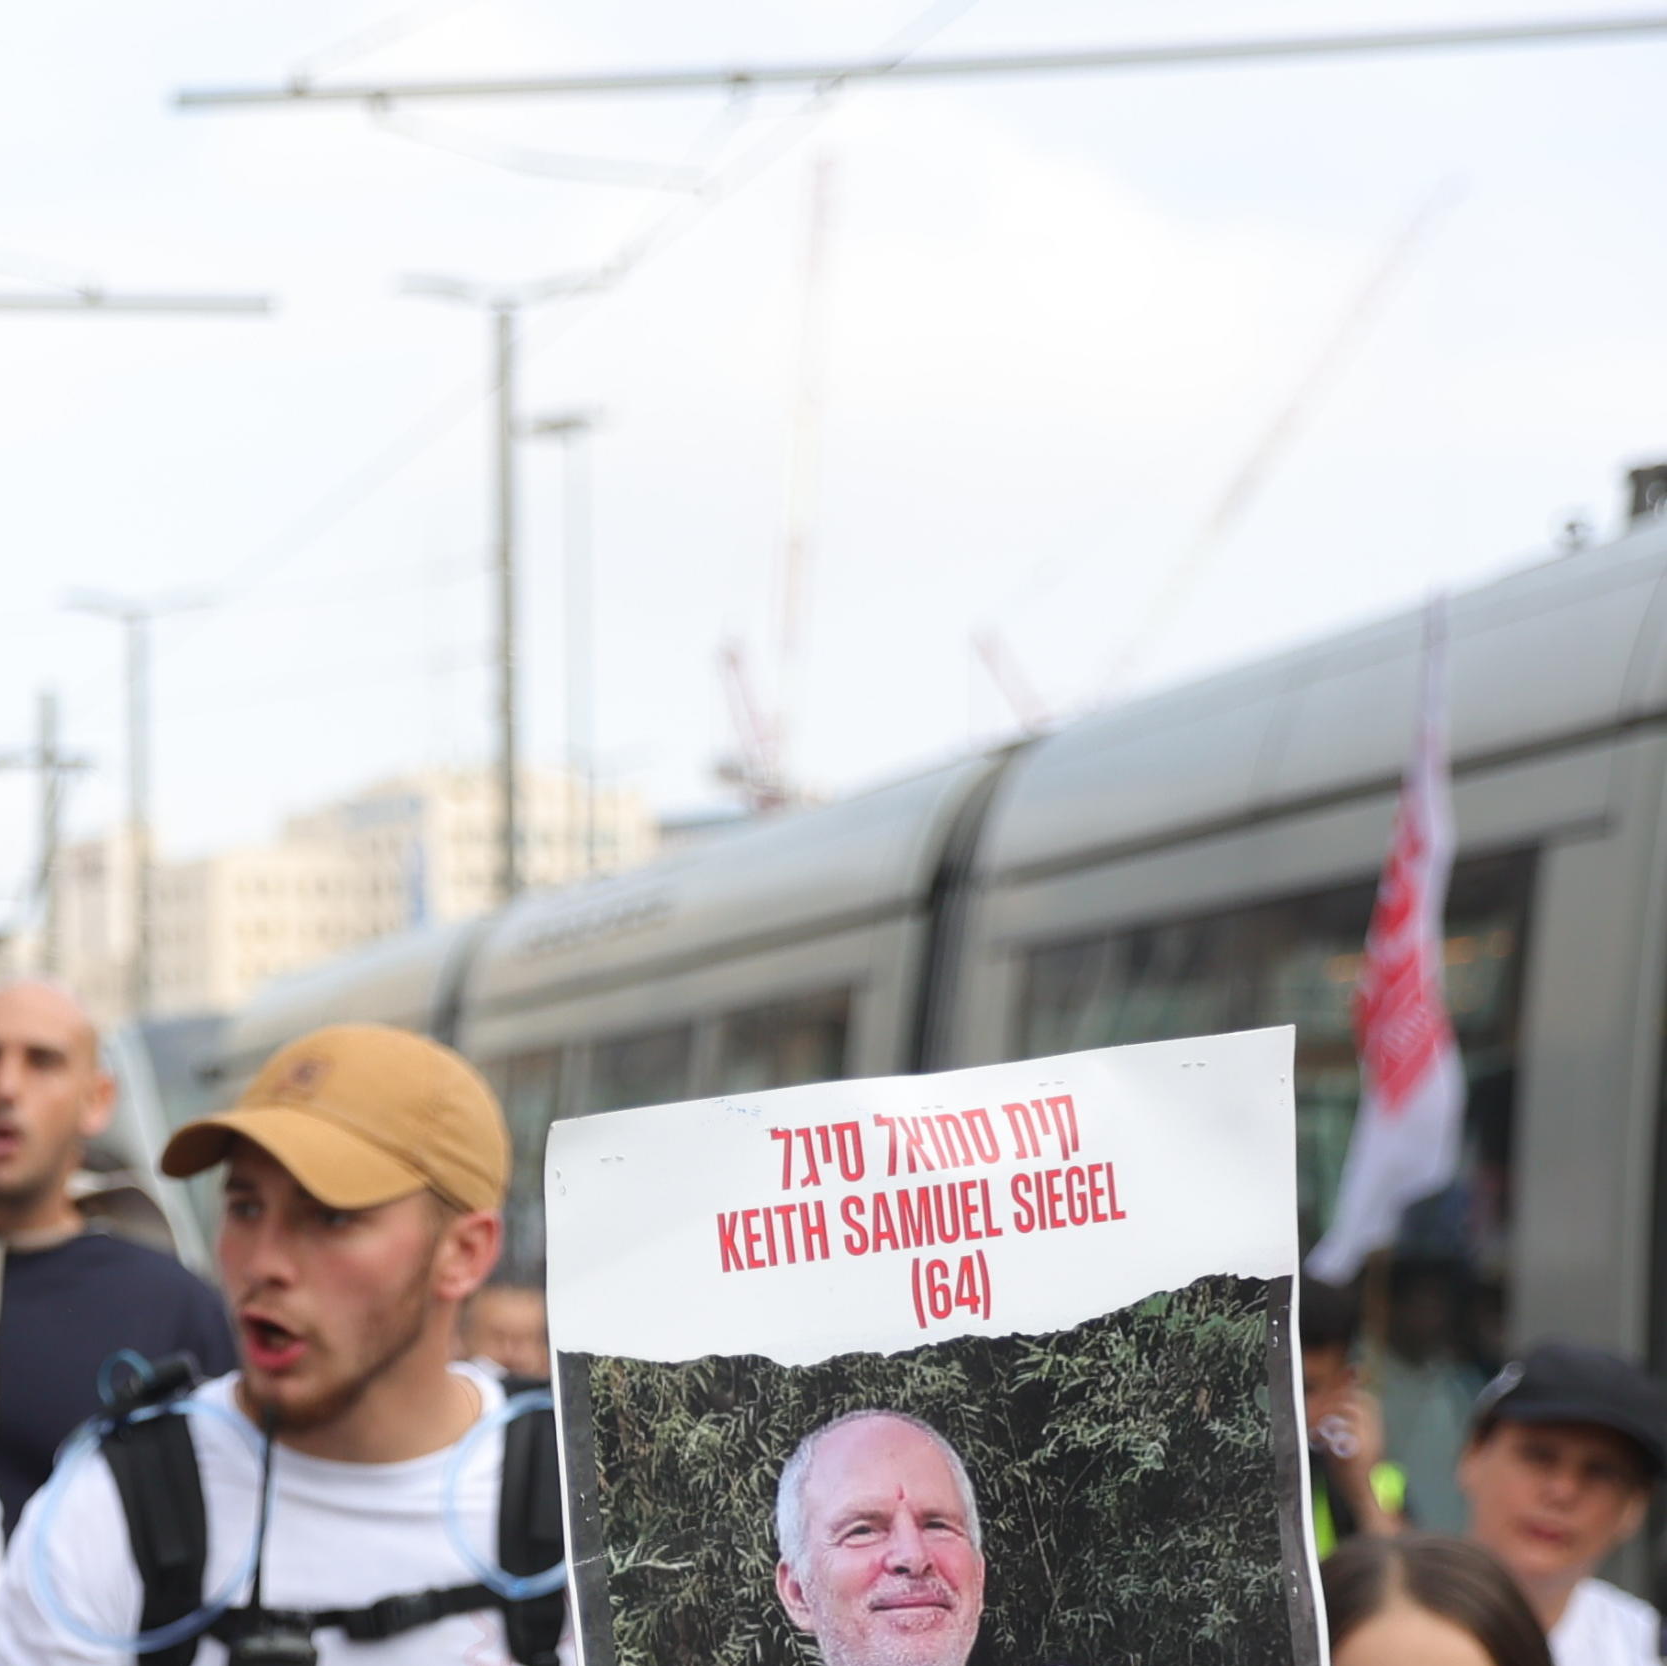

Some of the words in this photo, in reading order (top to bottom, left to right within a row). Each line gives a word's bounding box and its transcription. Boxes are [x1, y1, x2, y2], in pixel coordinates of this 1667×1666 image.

[770, 1121, 866, 1190] סיגל
[873, 1108, 1002, 1177] סמואל
[1002, 1093, 1082, 1162] קית
[716, 1199, 831, 1273] KEITH
[842, 1178, 1003, 1258] SAMUEL
[1012, 1161, 1127, 1236] SIEGEL
[911, 1249, 992, 1329] (64)
